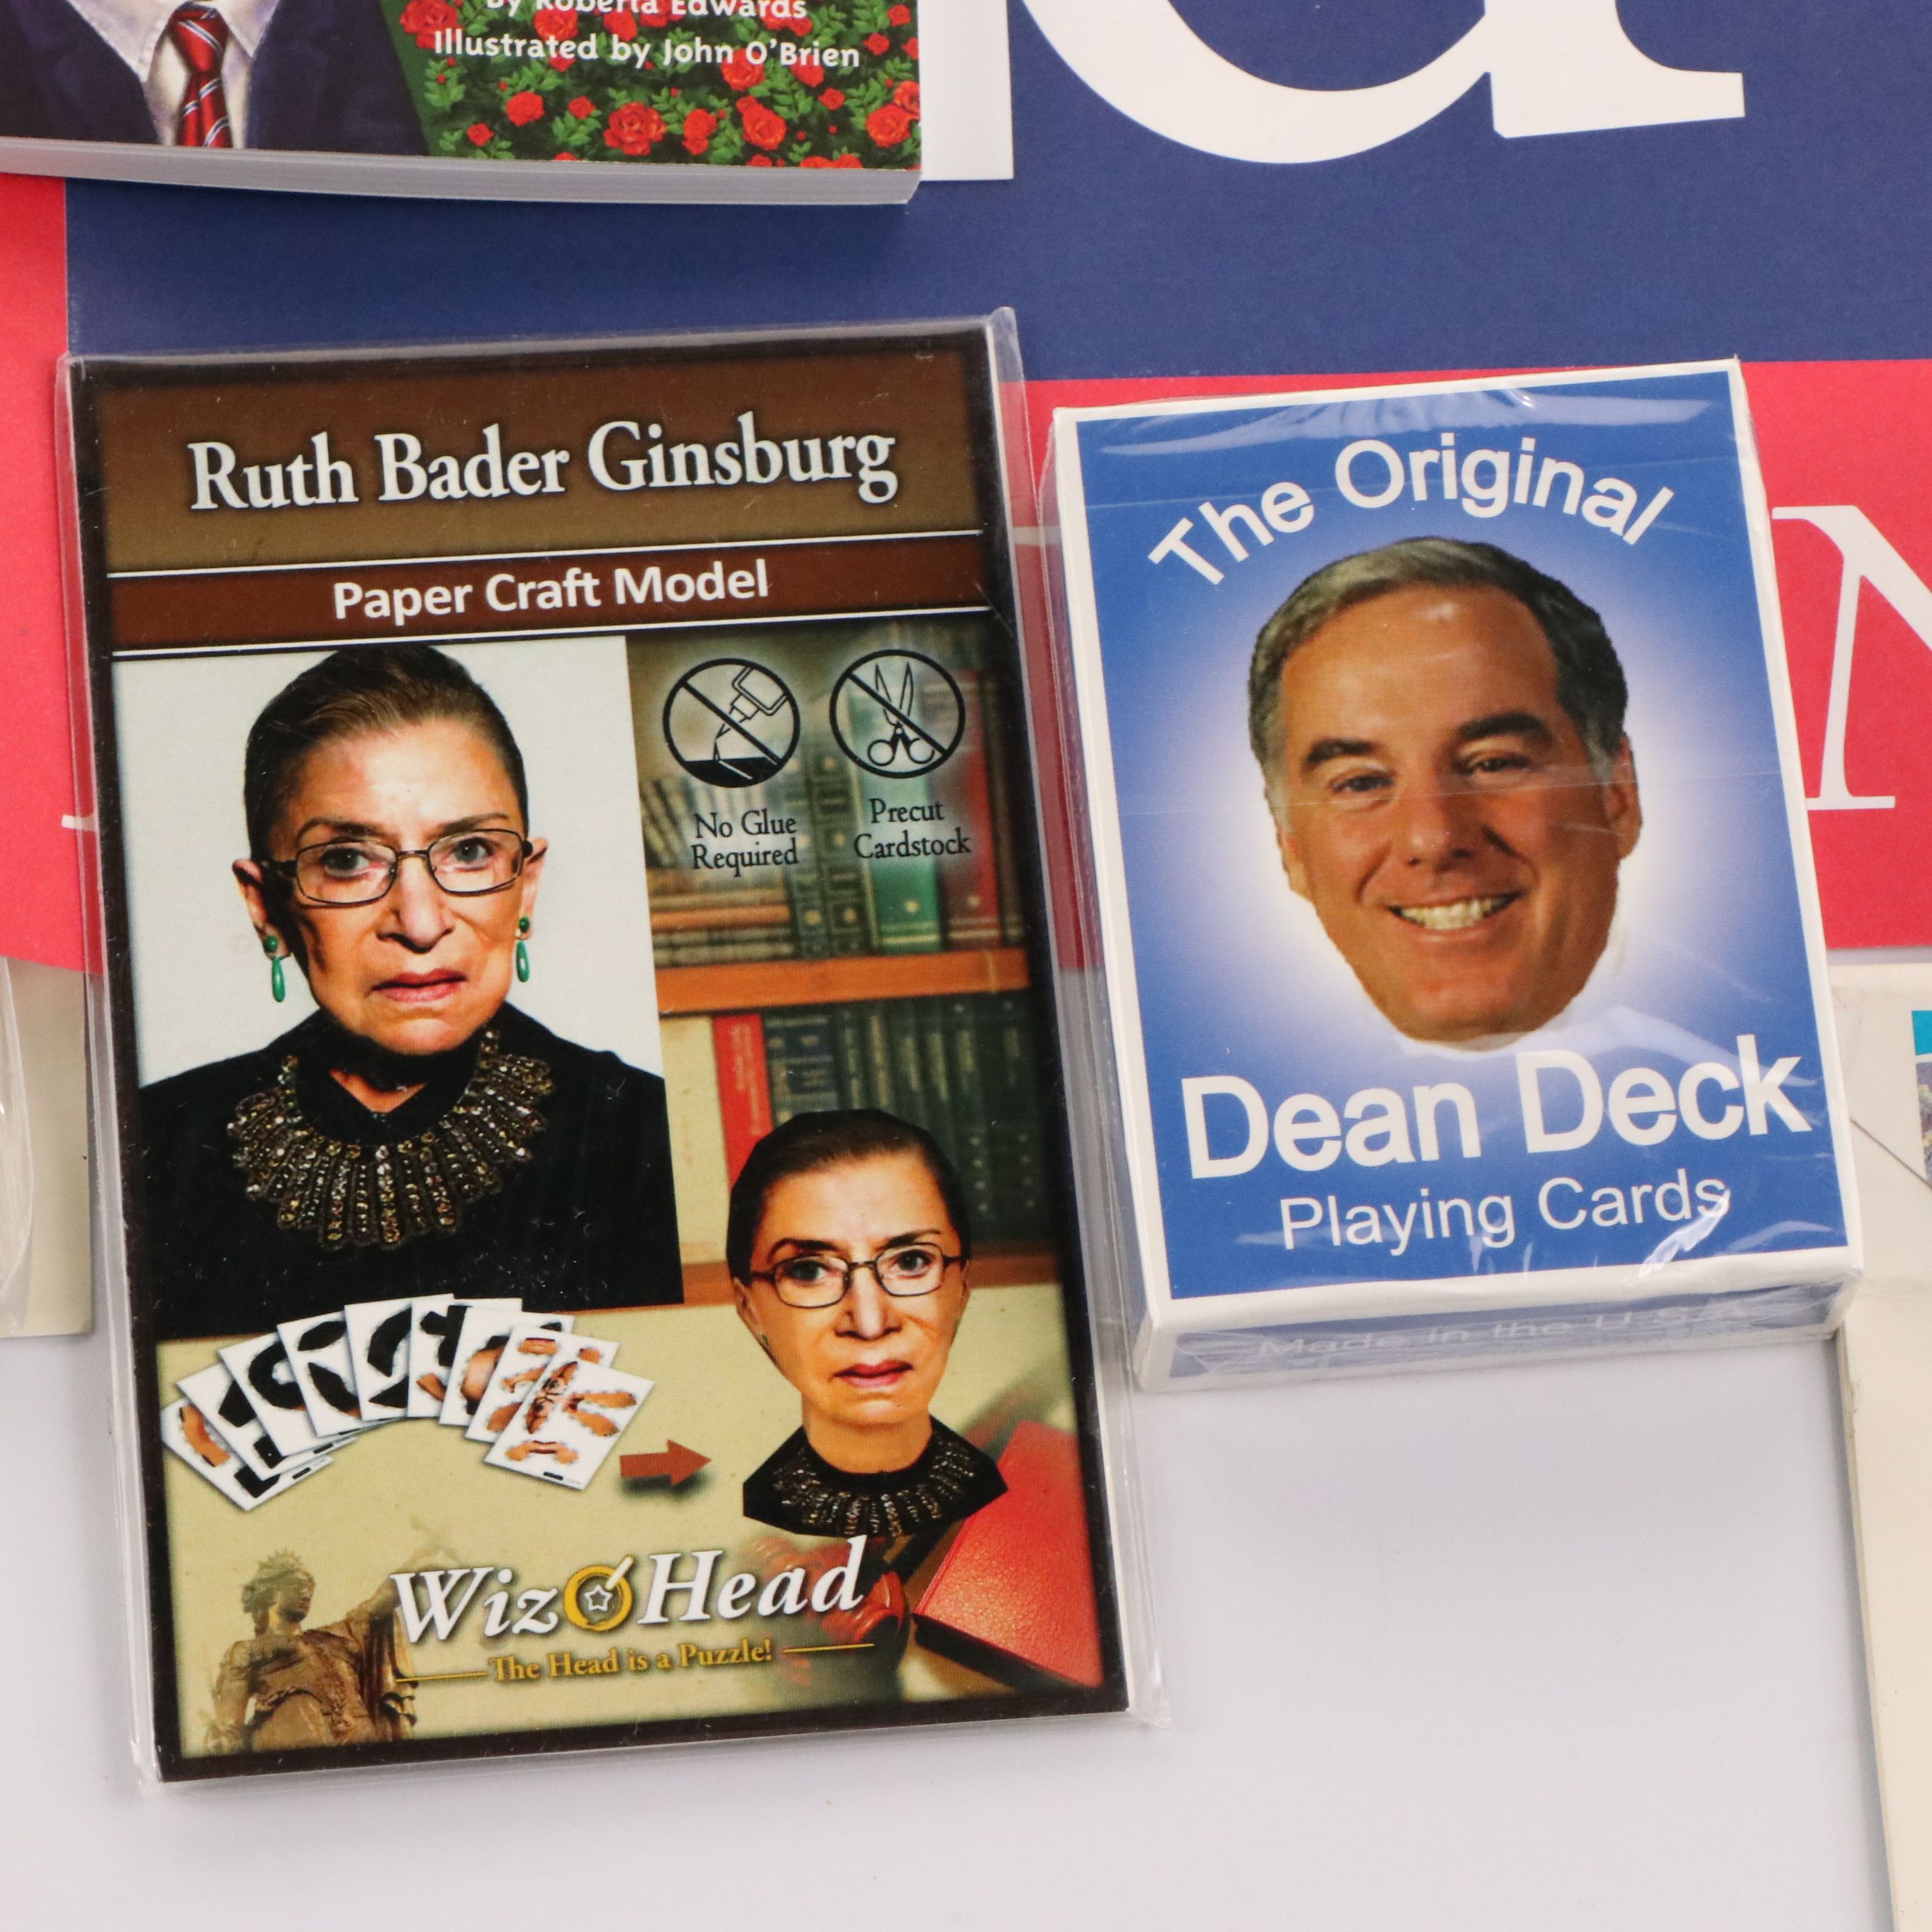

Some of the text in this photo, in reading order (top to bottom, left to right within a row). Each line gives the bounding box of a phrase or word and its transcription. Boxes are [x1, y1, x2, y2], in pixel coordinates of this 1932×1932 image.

[671, 0, 807, 19] Edwards
[434, 27, 599, 60] Illustrated
[611, 33, 651, 69] by
[663, 36, 734, 66] John
[187, 412, 899, 511] Ruth Bader Ginsburg
[1147, 432, 1674, 586] The Original
[333, 558, 769, 626] Paper Craft Model
[693, 808, 797, 839] No Glue
[869, 797, 944, 824] Precut
[691, 838, 799, 877] Required
[853, 827, 972, 859] Cardstock
[1180, 1034, 1813, 1179] Dean Deck
[1280, 1168, 1731, 1257] Playing Cards
[487, 1637, 773, 1682] The Head is a Puzzle!
